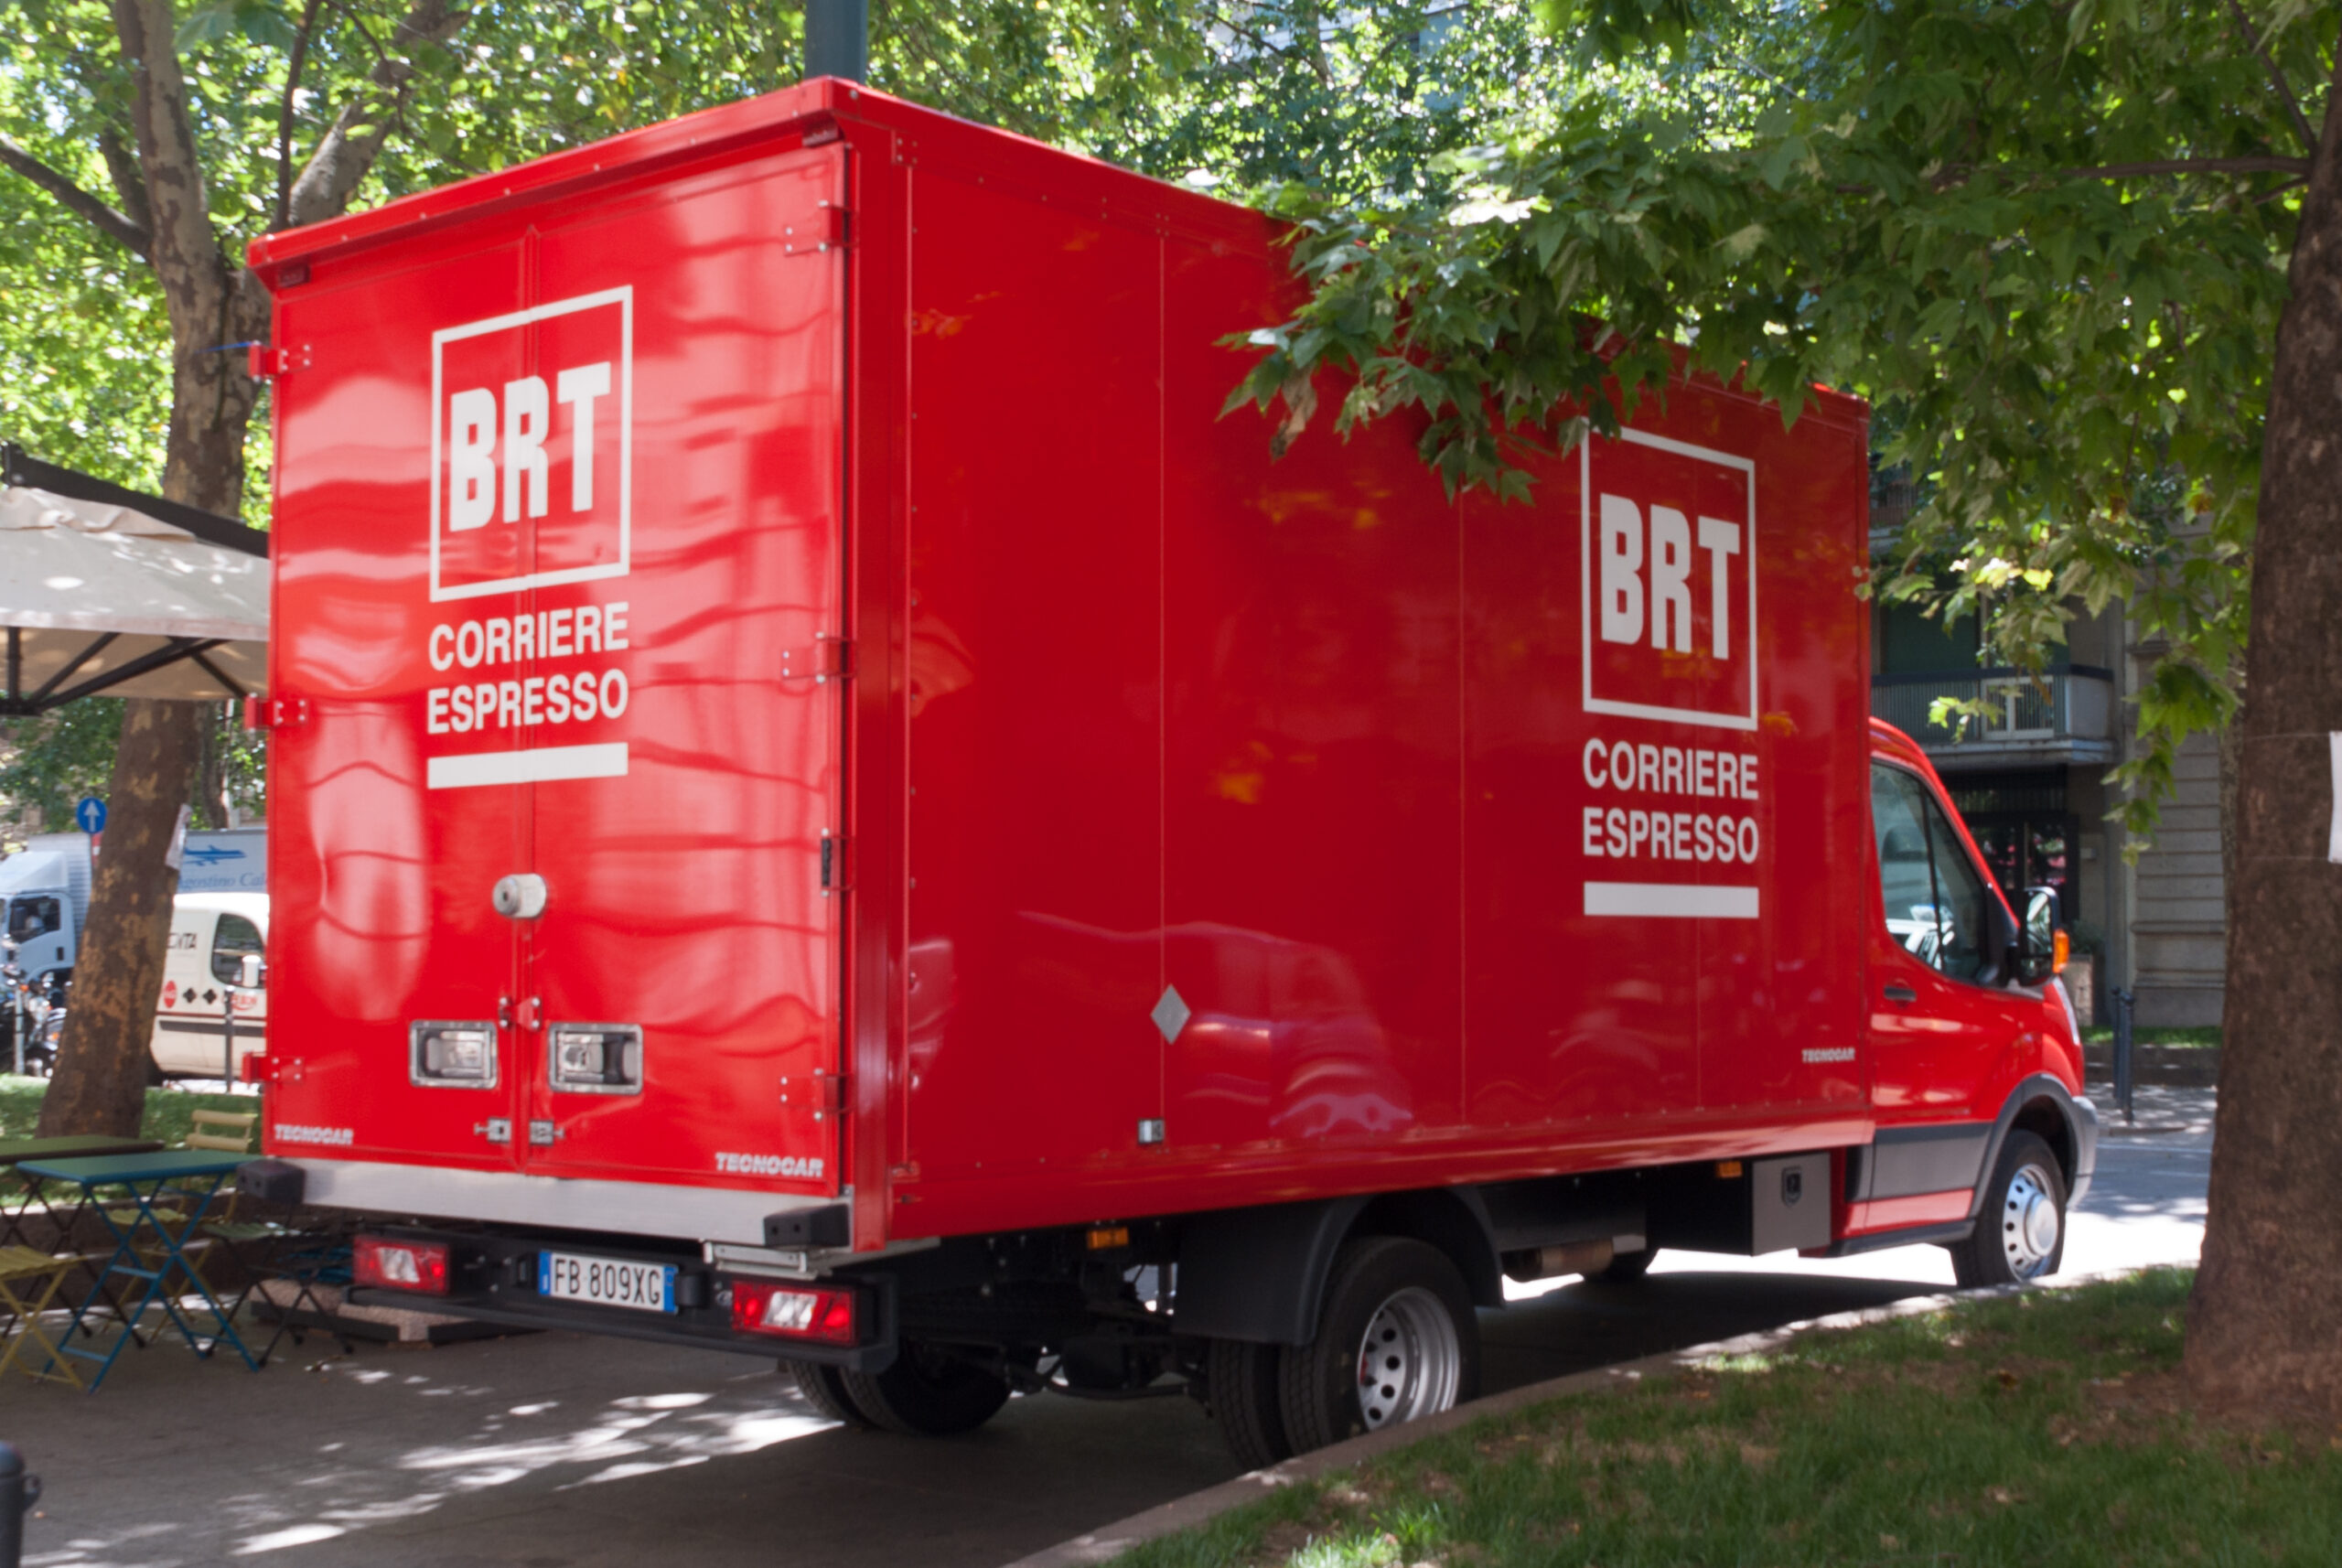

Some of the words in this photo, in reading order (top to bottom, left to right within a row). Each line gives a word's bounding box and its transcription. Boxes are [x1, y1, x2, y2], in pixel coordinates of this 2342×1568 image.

[449, 361, 611, 532] BRT
[1600, 492, 1740, 660] BRT
[429, 602, 628, 671] CORRIERE
[427, 669, 628, 734] ESPRESSO
[1583, 737, 1759, 800] CORRIERE
[1583, 807, 1759, 864] ESPRESSO
[178, 875, 236, 891] gostino
[1801, 1047, 1855, 1063] TECNOCAR
[274, 1123, 353, 1145] TECNOCAR
[714, 1152, 823, 1178] TECNOCAR
[554, 1258, 580, 1294] FB
[589, 1262, 661, 1305] 809XG
